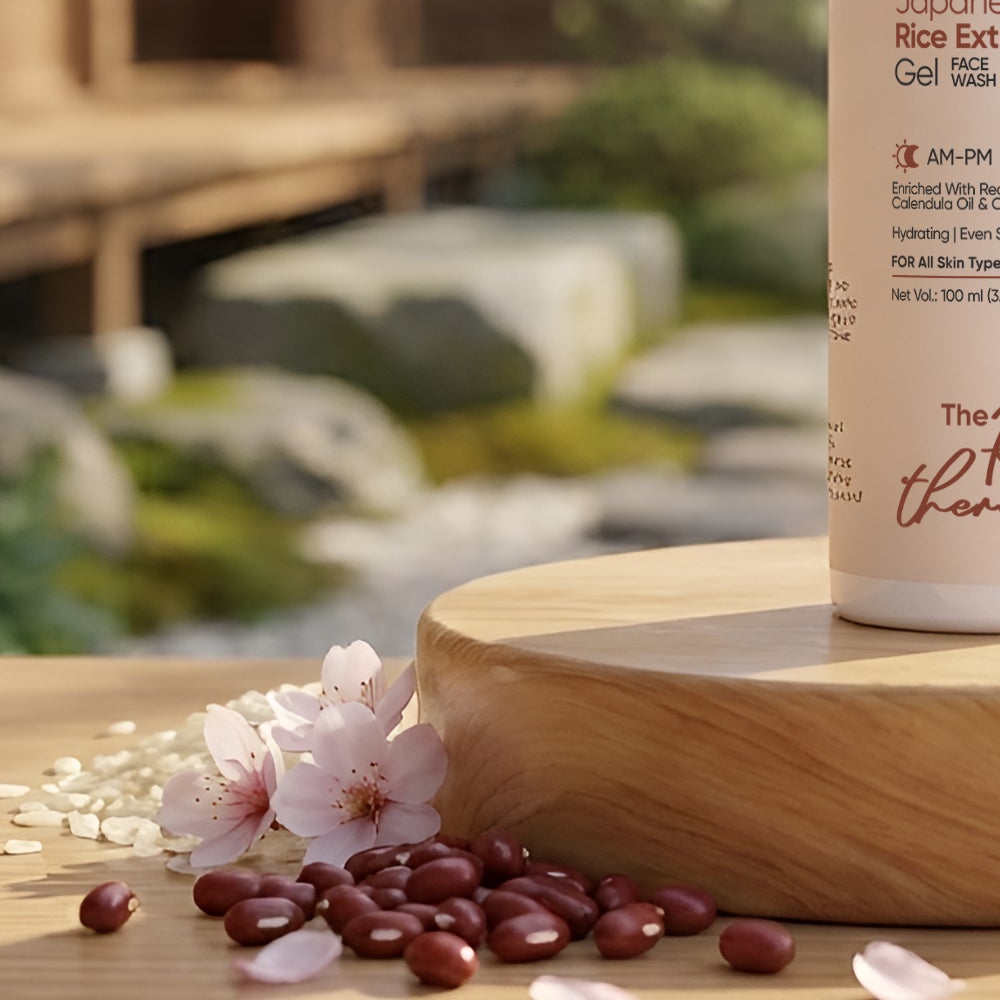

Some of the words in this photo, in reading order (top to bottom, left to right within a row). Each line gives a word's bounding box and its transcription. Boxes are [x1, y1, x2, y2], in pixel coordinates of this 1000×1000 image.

[895, 22, 948, 49] Rice
[894, 57, 939, 87] Gel
[951, 57, 989, 71] FACE
[951, 73, 997, 87] WASH
[926, 148, 993, 166] AM-PM
[892, 181, 942, 196] Enriched
[945, 182, 976, 196] With
[892, 196, 953, 211] Calendula
[956, 196, 974, 211] Oil
[978, 197, 988, 211] &
[892, 225, 950, 244] Hydrating
[960, 227, 993, 241] Even
[891, 255, 915, 269] FOR
[918, 255, 934, 269] All
[937, 256, 965, 270] Skin
[891, 287, 911, 302] Net
[913, 288, 938, 303] Vol.:
[941, 289, 964, 303] 100
[967, 289, 984, 303] ml
[941, 403, 989, 427] The
